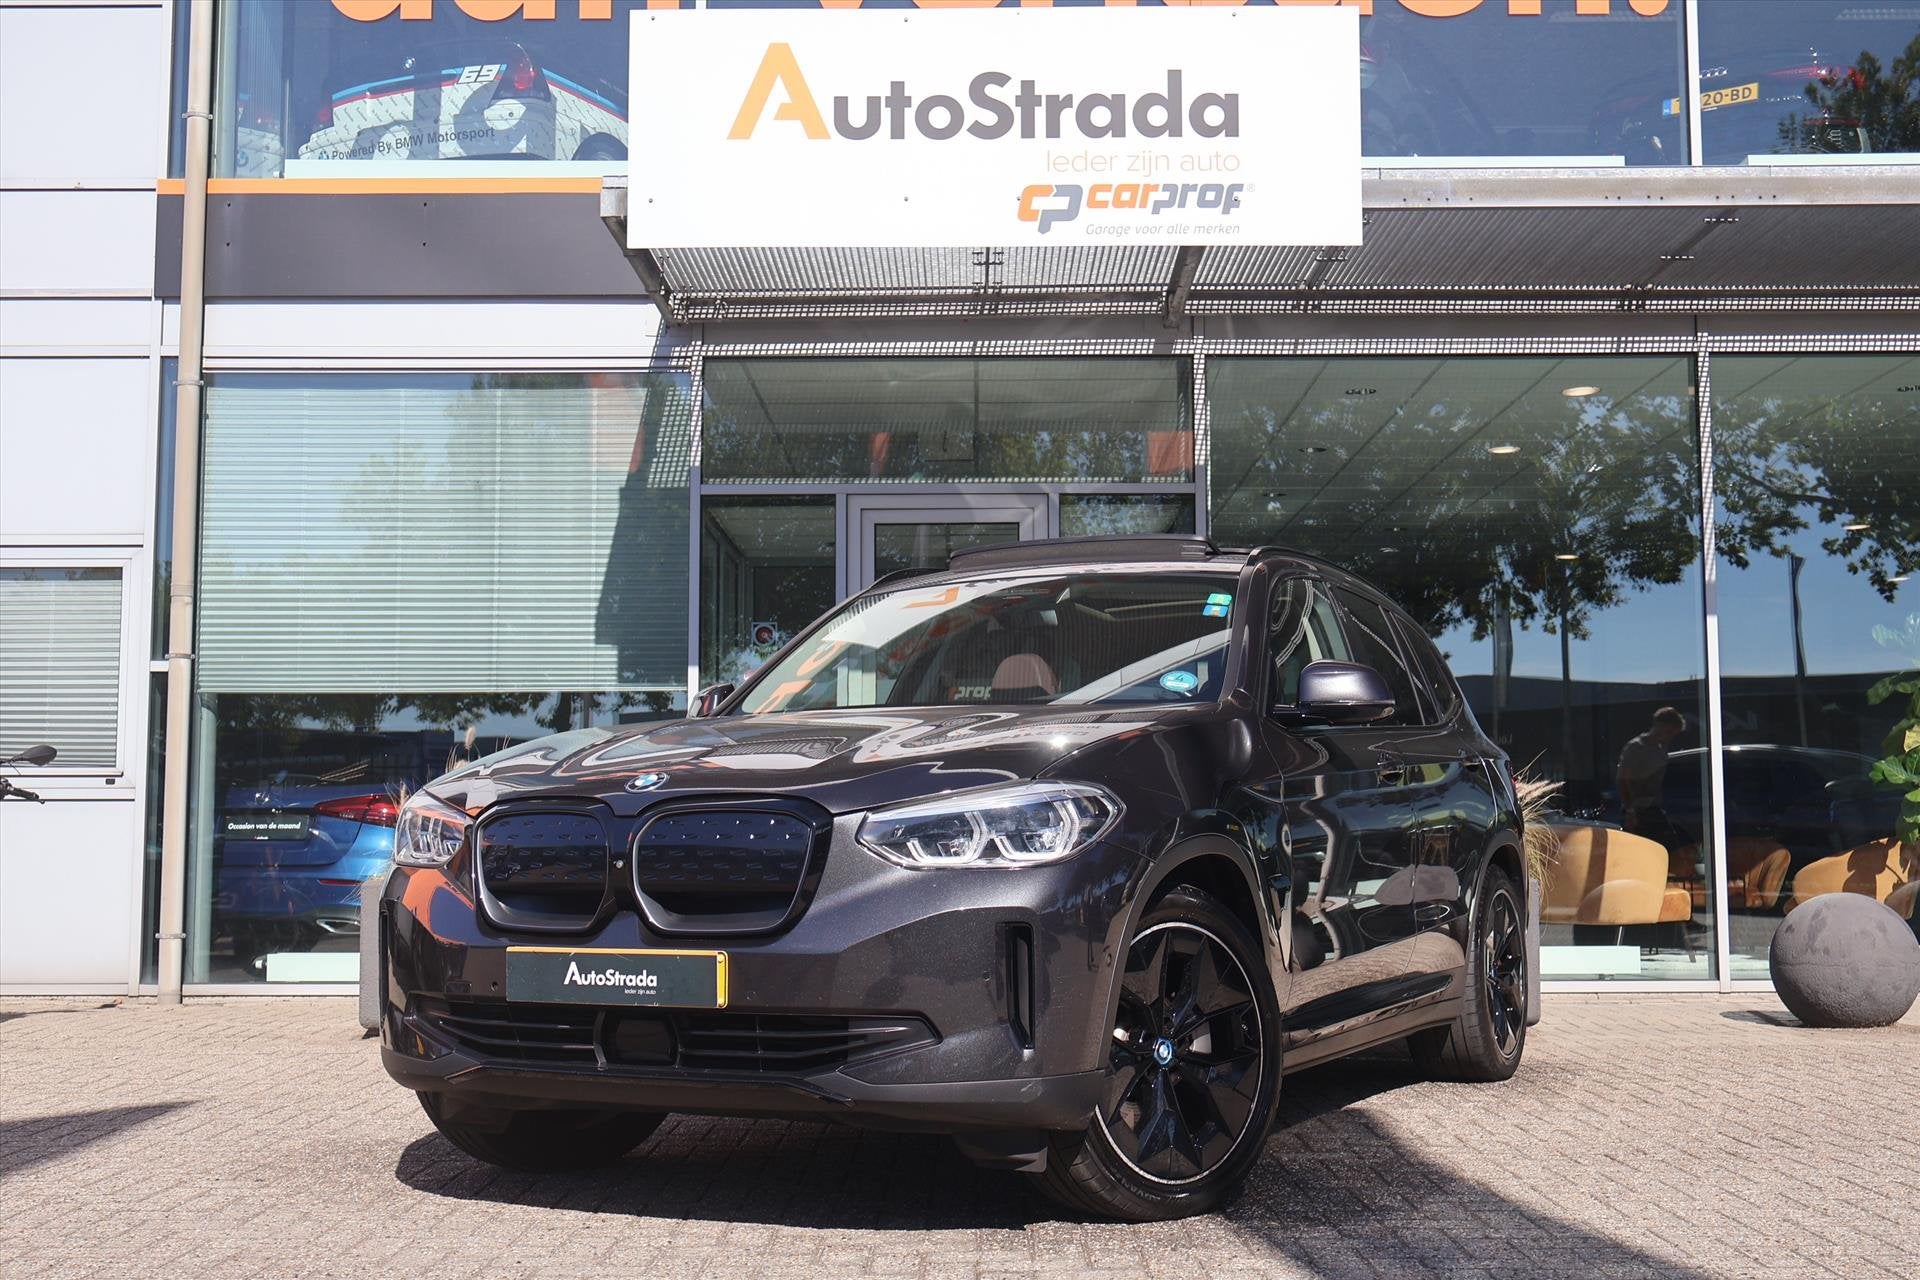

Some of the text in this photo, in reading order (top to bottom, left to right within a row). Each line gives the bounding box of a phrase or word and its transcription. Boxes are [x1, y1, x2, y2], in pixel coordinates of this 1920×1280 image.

[457, 64, 501, 84] 69
[726, 42, 1240, 141] AutoStrada
[1702, 87, 1752, 107] 20-BD
[332, 126, 495, 160] Powered By BMW Motorsport
[1046, 150, 1240, 177] Ieder zijn auto
[1086, 223, 1240, 237] Garage voor alle merken
[227, 822, 255, 830] Occasion
[563, 961, 657, 987] AutoStrada
